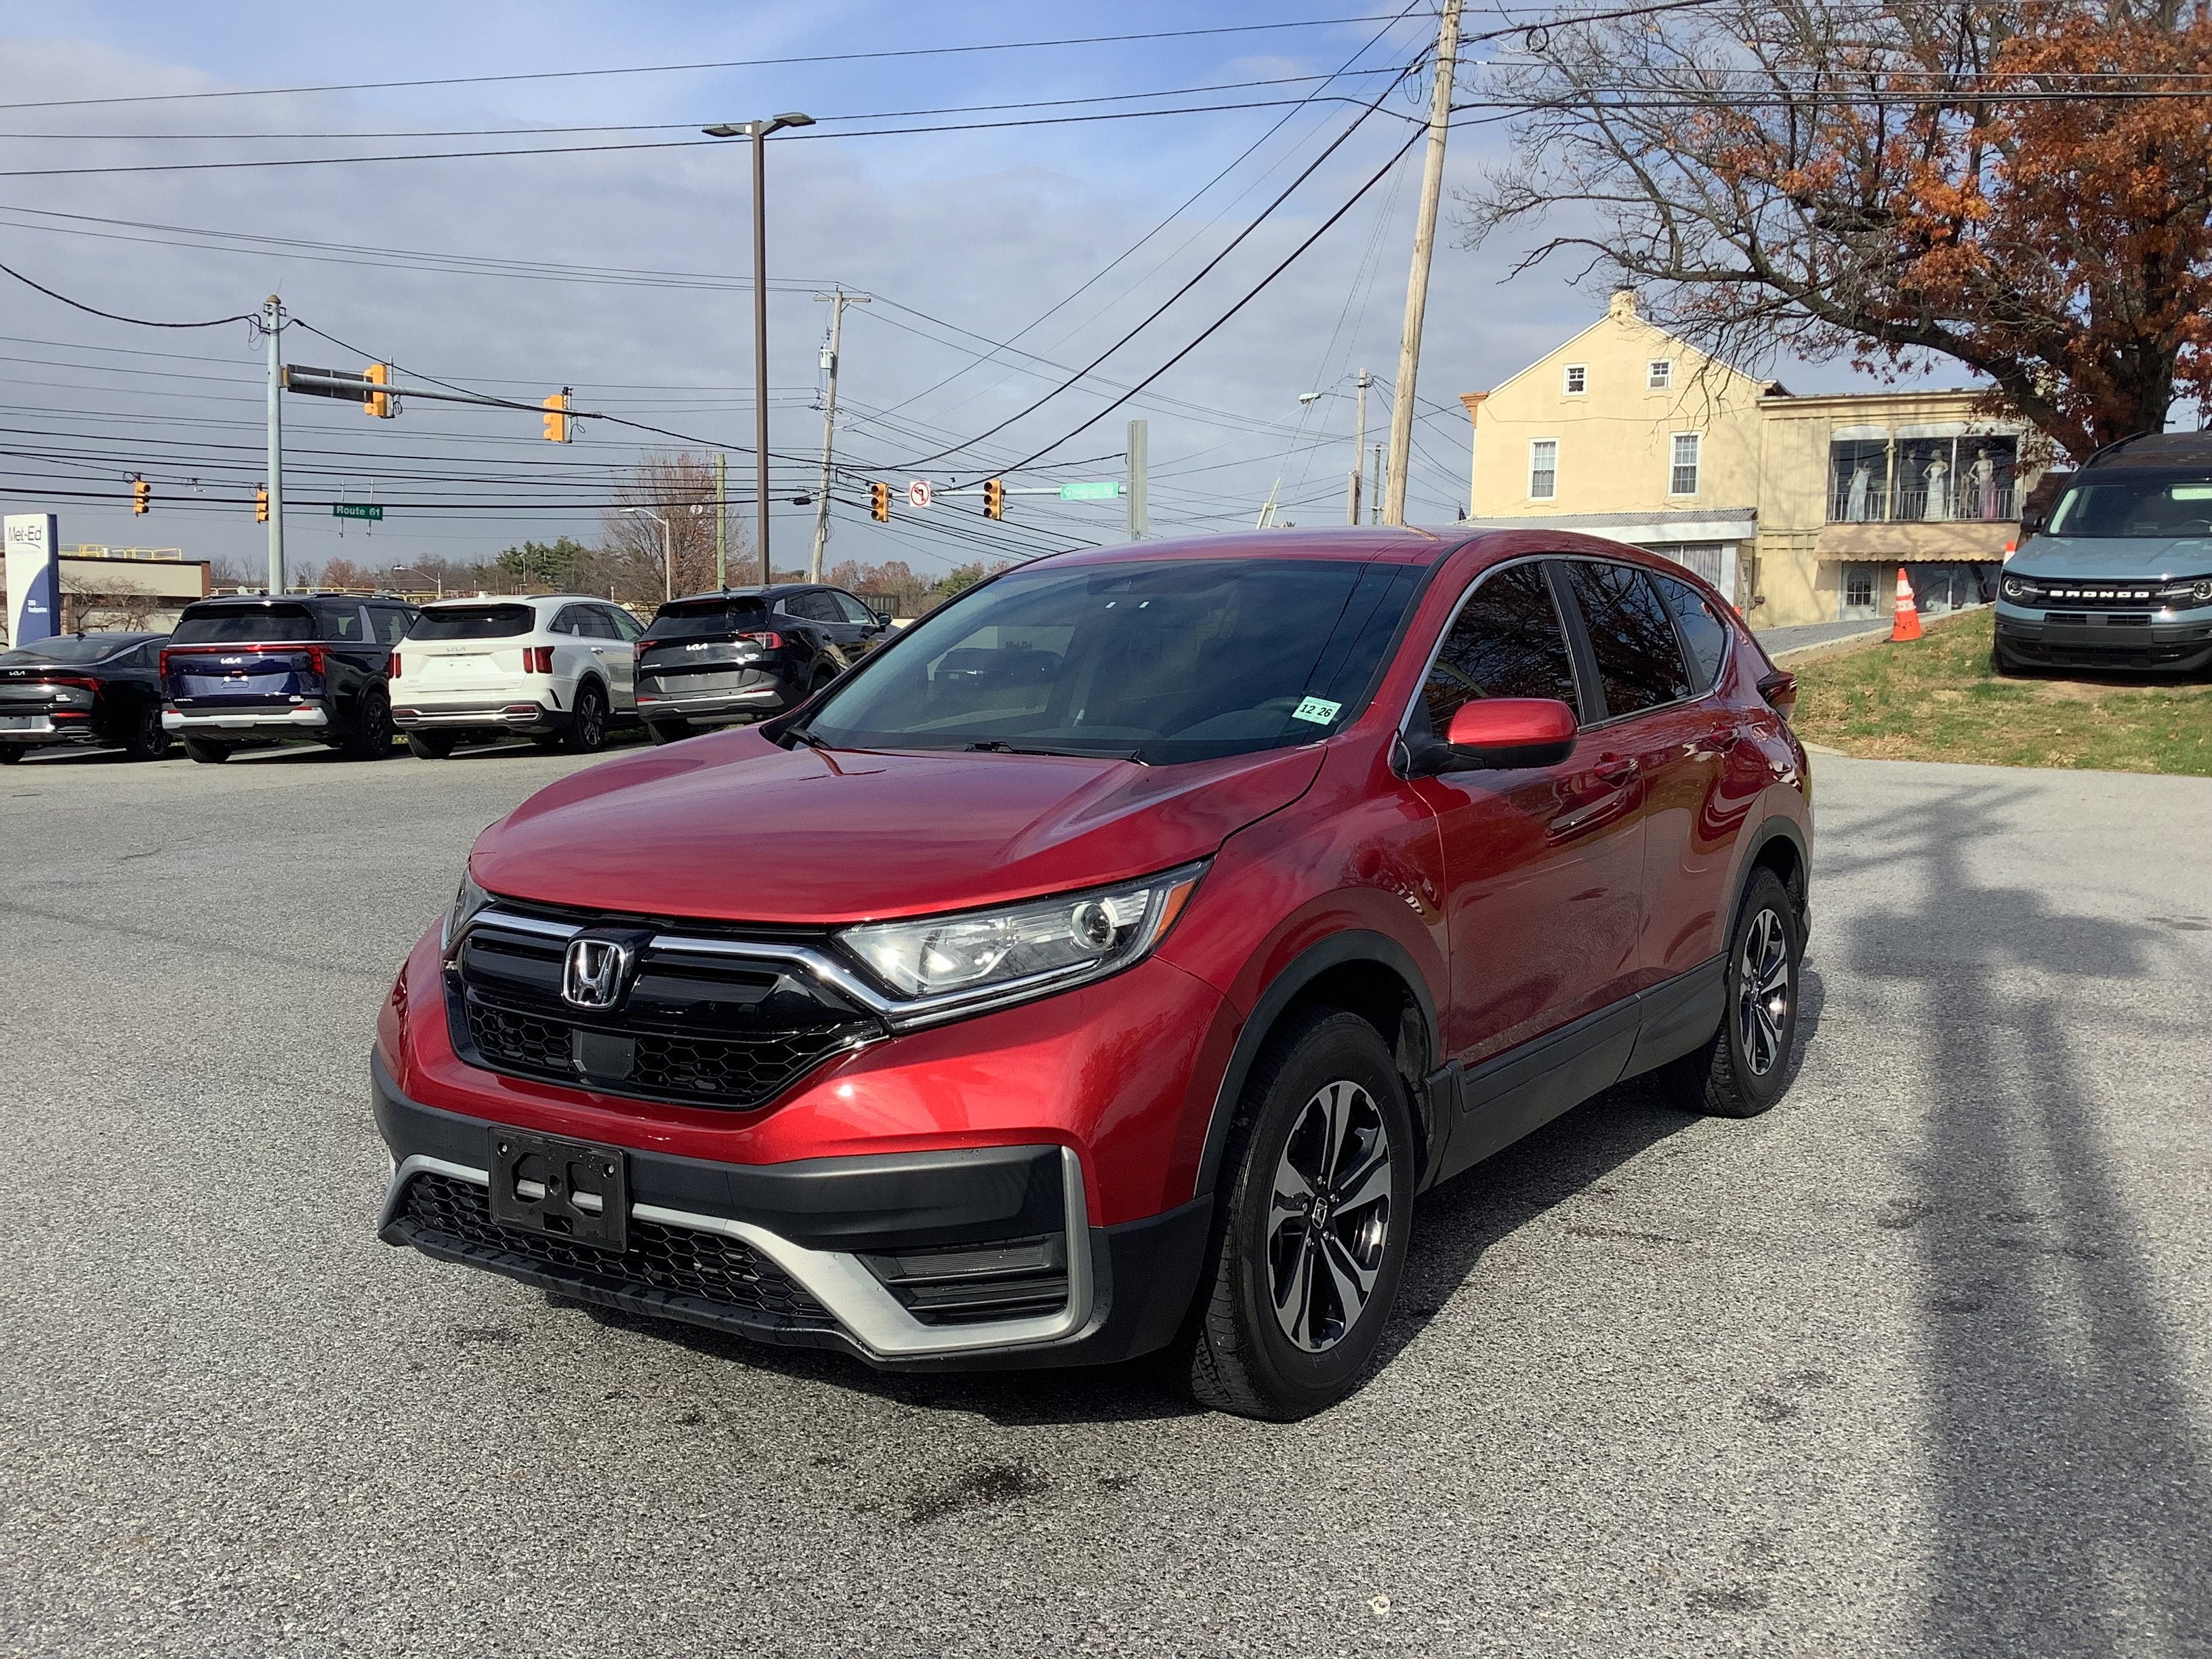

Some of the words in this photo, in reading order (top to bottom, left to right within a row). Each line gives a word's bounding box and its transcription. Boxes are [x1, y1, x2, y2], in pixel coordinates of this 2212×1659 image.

[336, 505, 365, 516] Route
[369, 508, 380, 516] 61
[8, 525, 42, 541] Met-Ed
[2049, 590, 2150, 598] BRONCO
[1299, 703, 1316, 714] 12
[1317, 706, 1333, 717] 26
